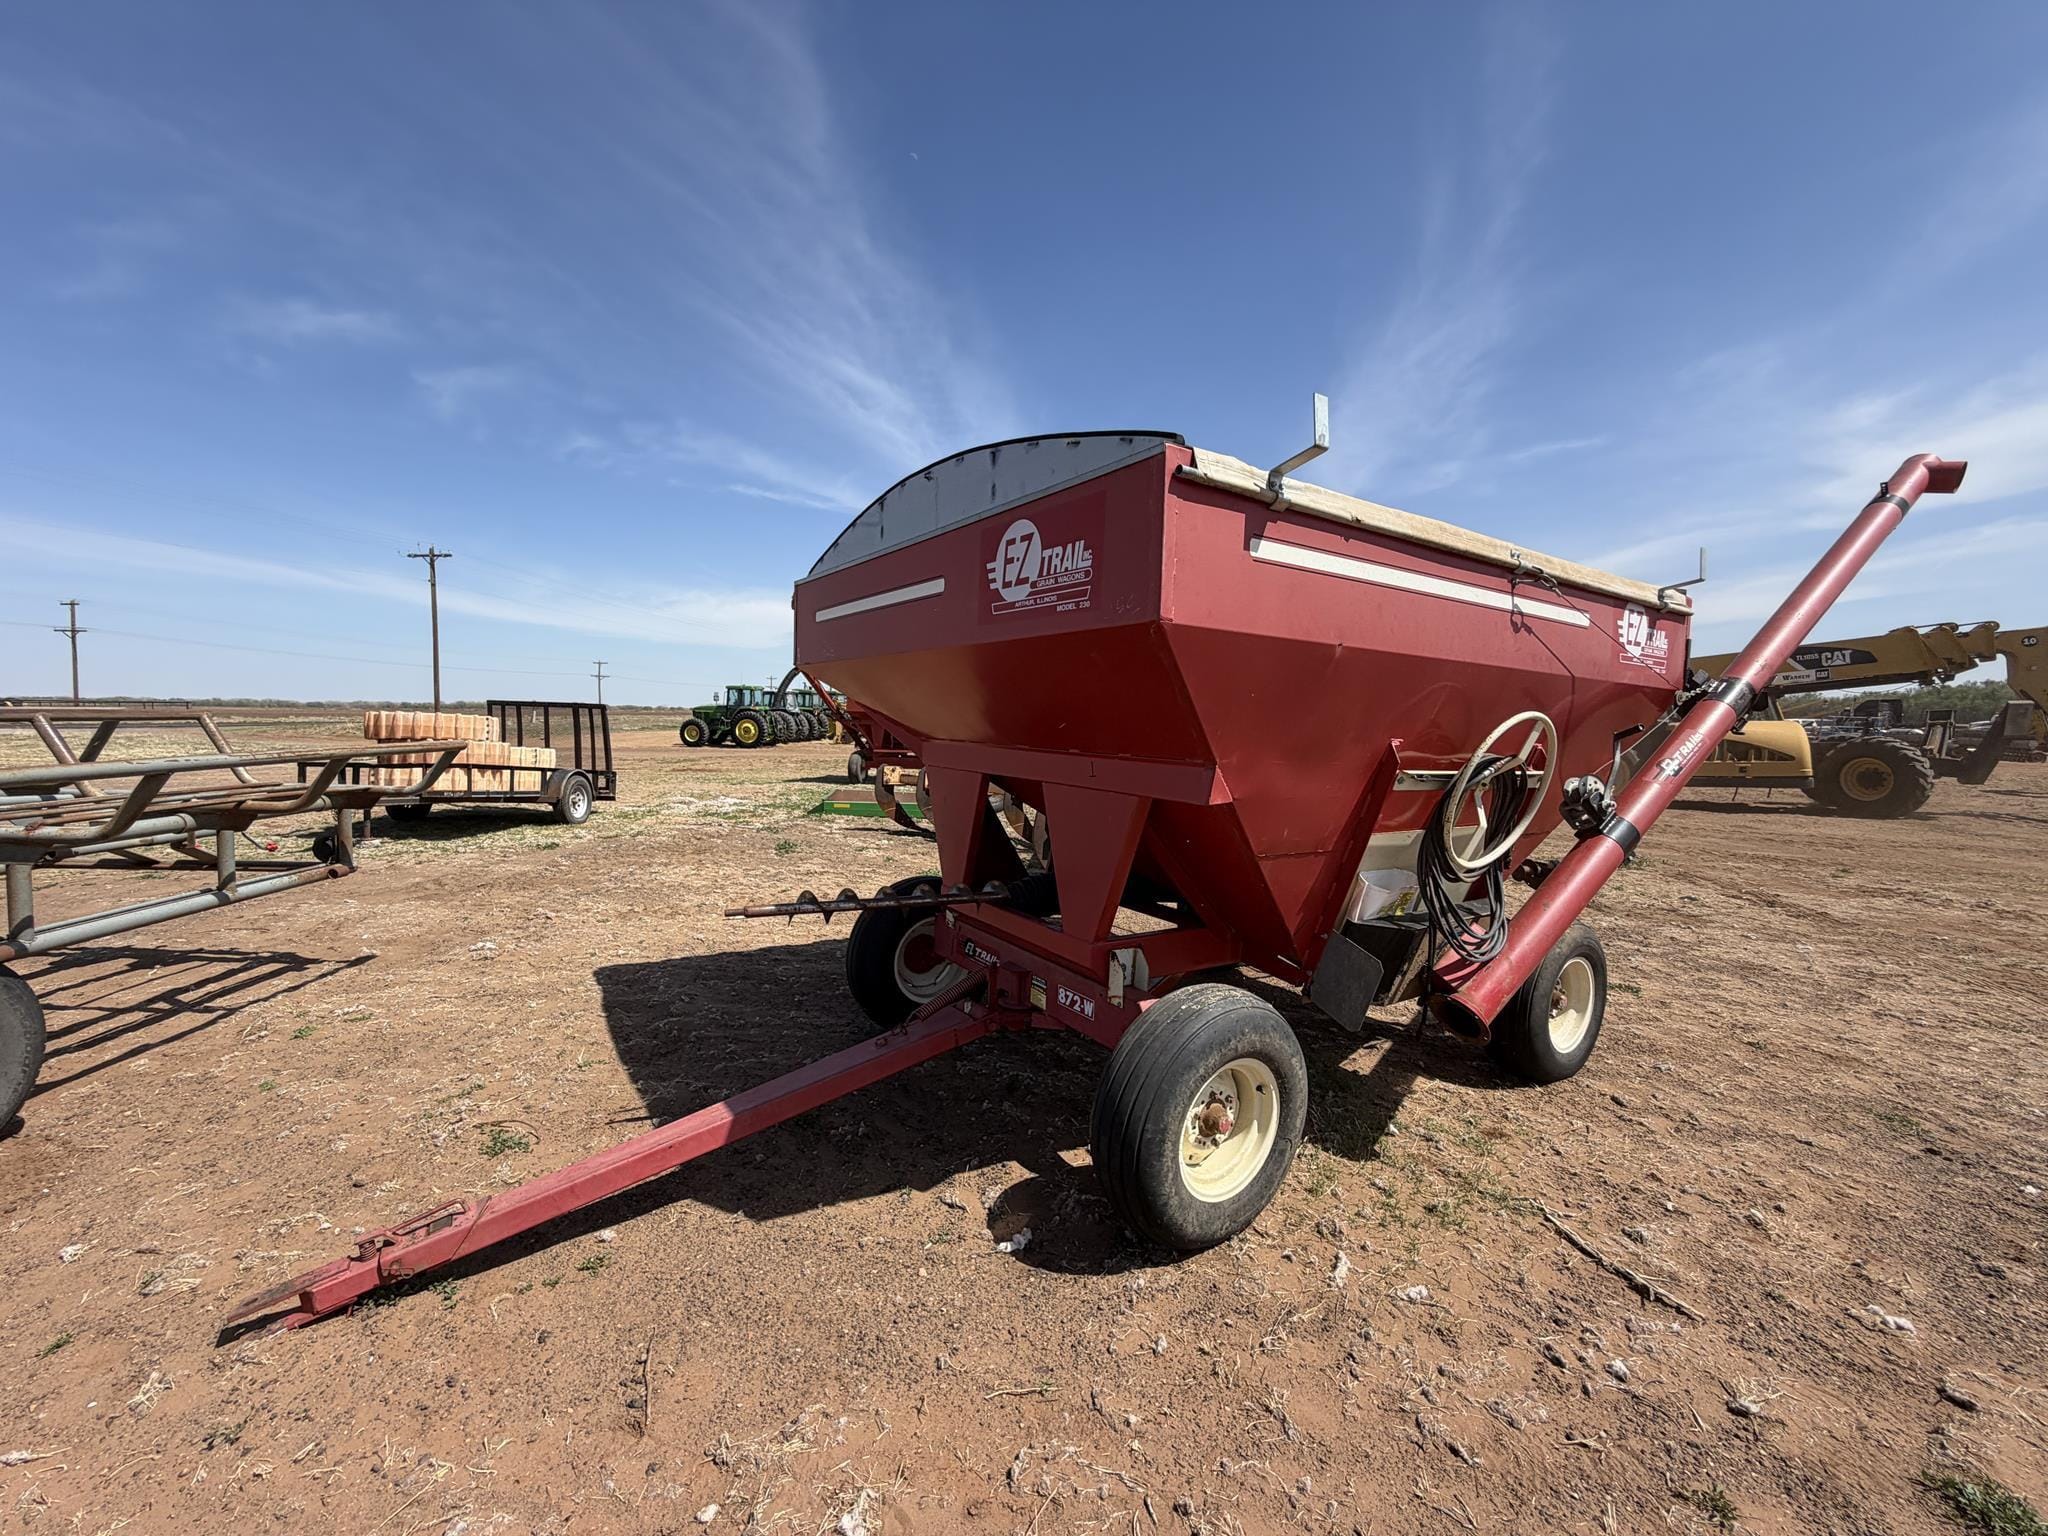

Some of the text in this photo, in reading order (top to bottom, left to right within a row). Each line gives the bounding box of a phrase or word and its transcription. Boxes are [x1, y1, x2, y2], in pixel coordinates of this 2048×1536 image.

[1042, 540, 1092, 577] TRAIL
[1036, 571, 1086, 588] GRAIN WAGONS
[1036, 595, 1058, 604] ILLINOIS
[1056, 602, 1077, 612] MODEL
[1821, 650, 1853, 666] CAT
[1058, 988, 1093, 1017] 872-W
